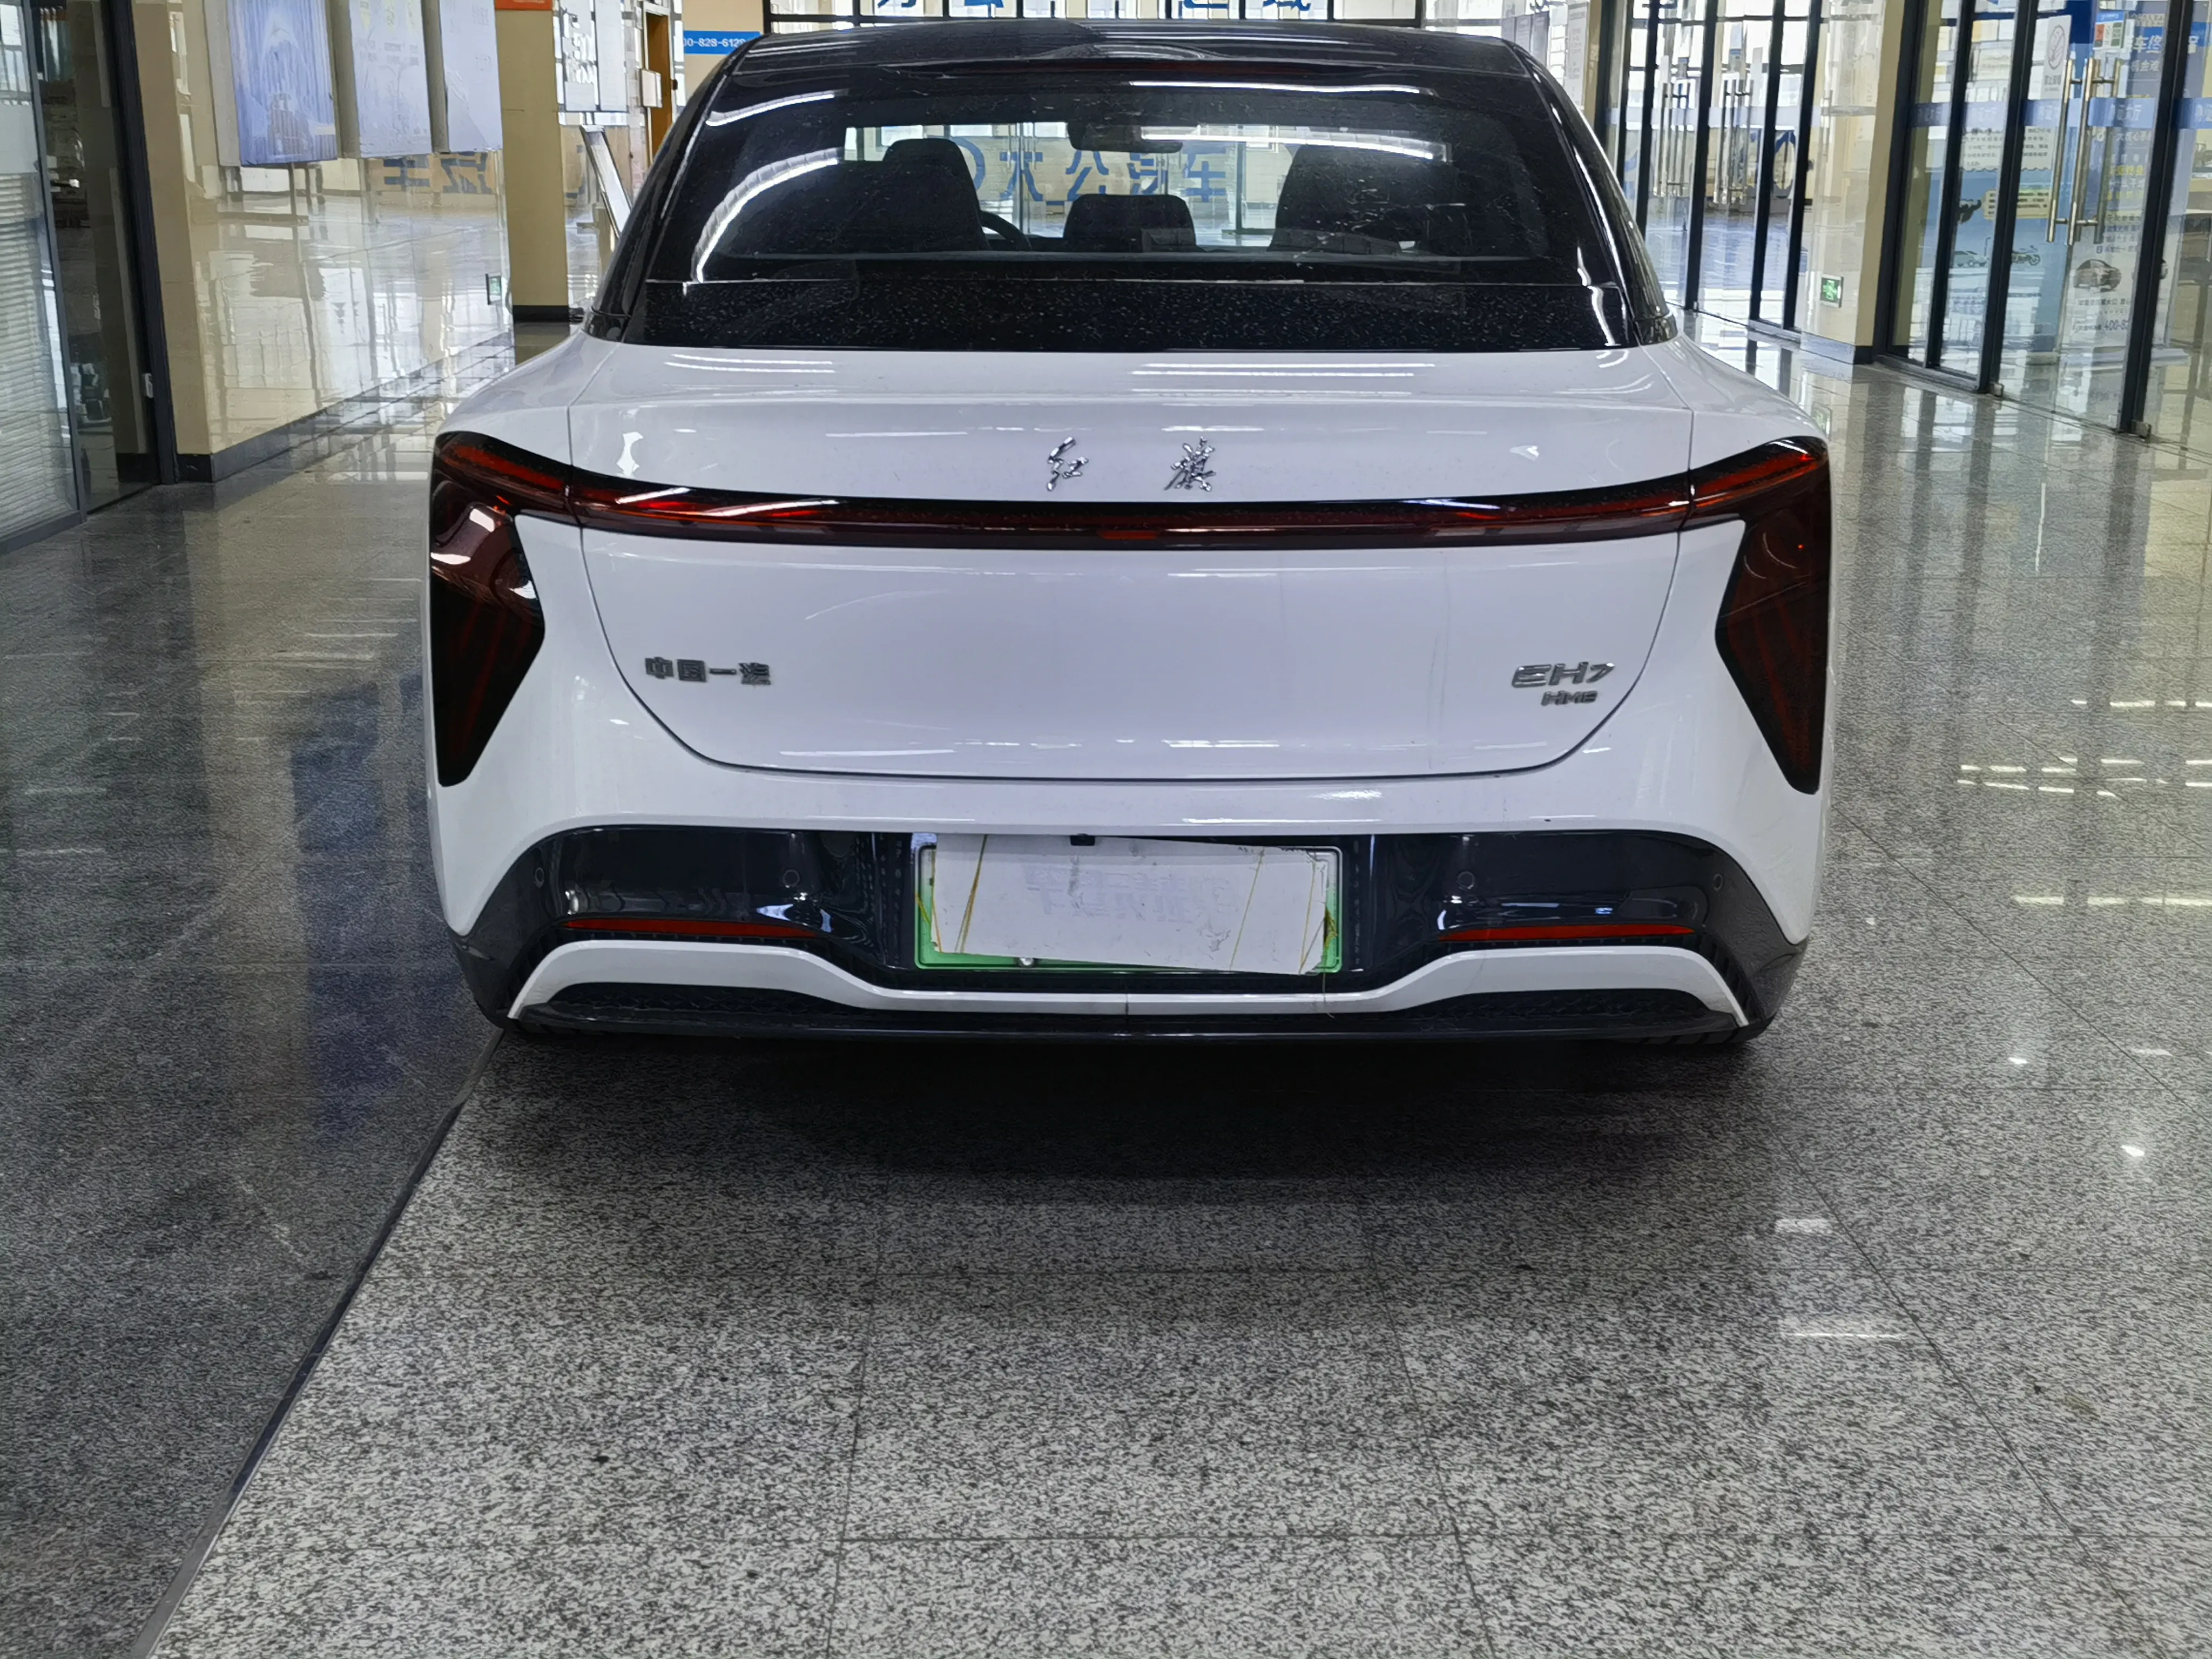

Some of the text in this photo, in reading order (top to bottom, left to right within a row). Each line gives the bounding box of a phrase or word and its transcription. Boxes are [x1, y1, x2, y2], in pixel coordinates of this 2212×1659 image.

[644, 656, 772, 686] 中国一汽
[1512, 661, 1615, 688] EH7
